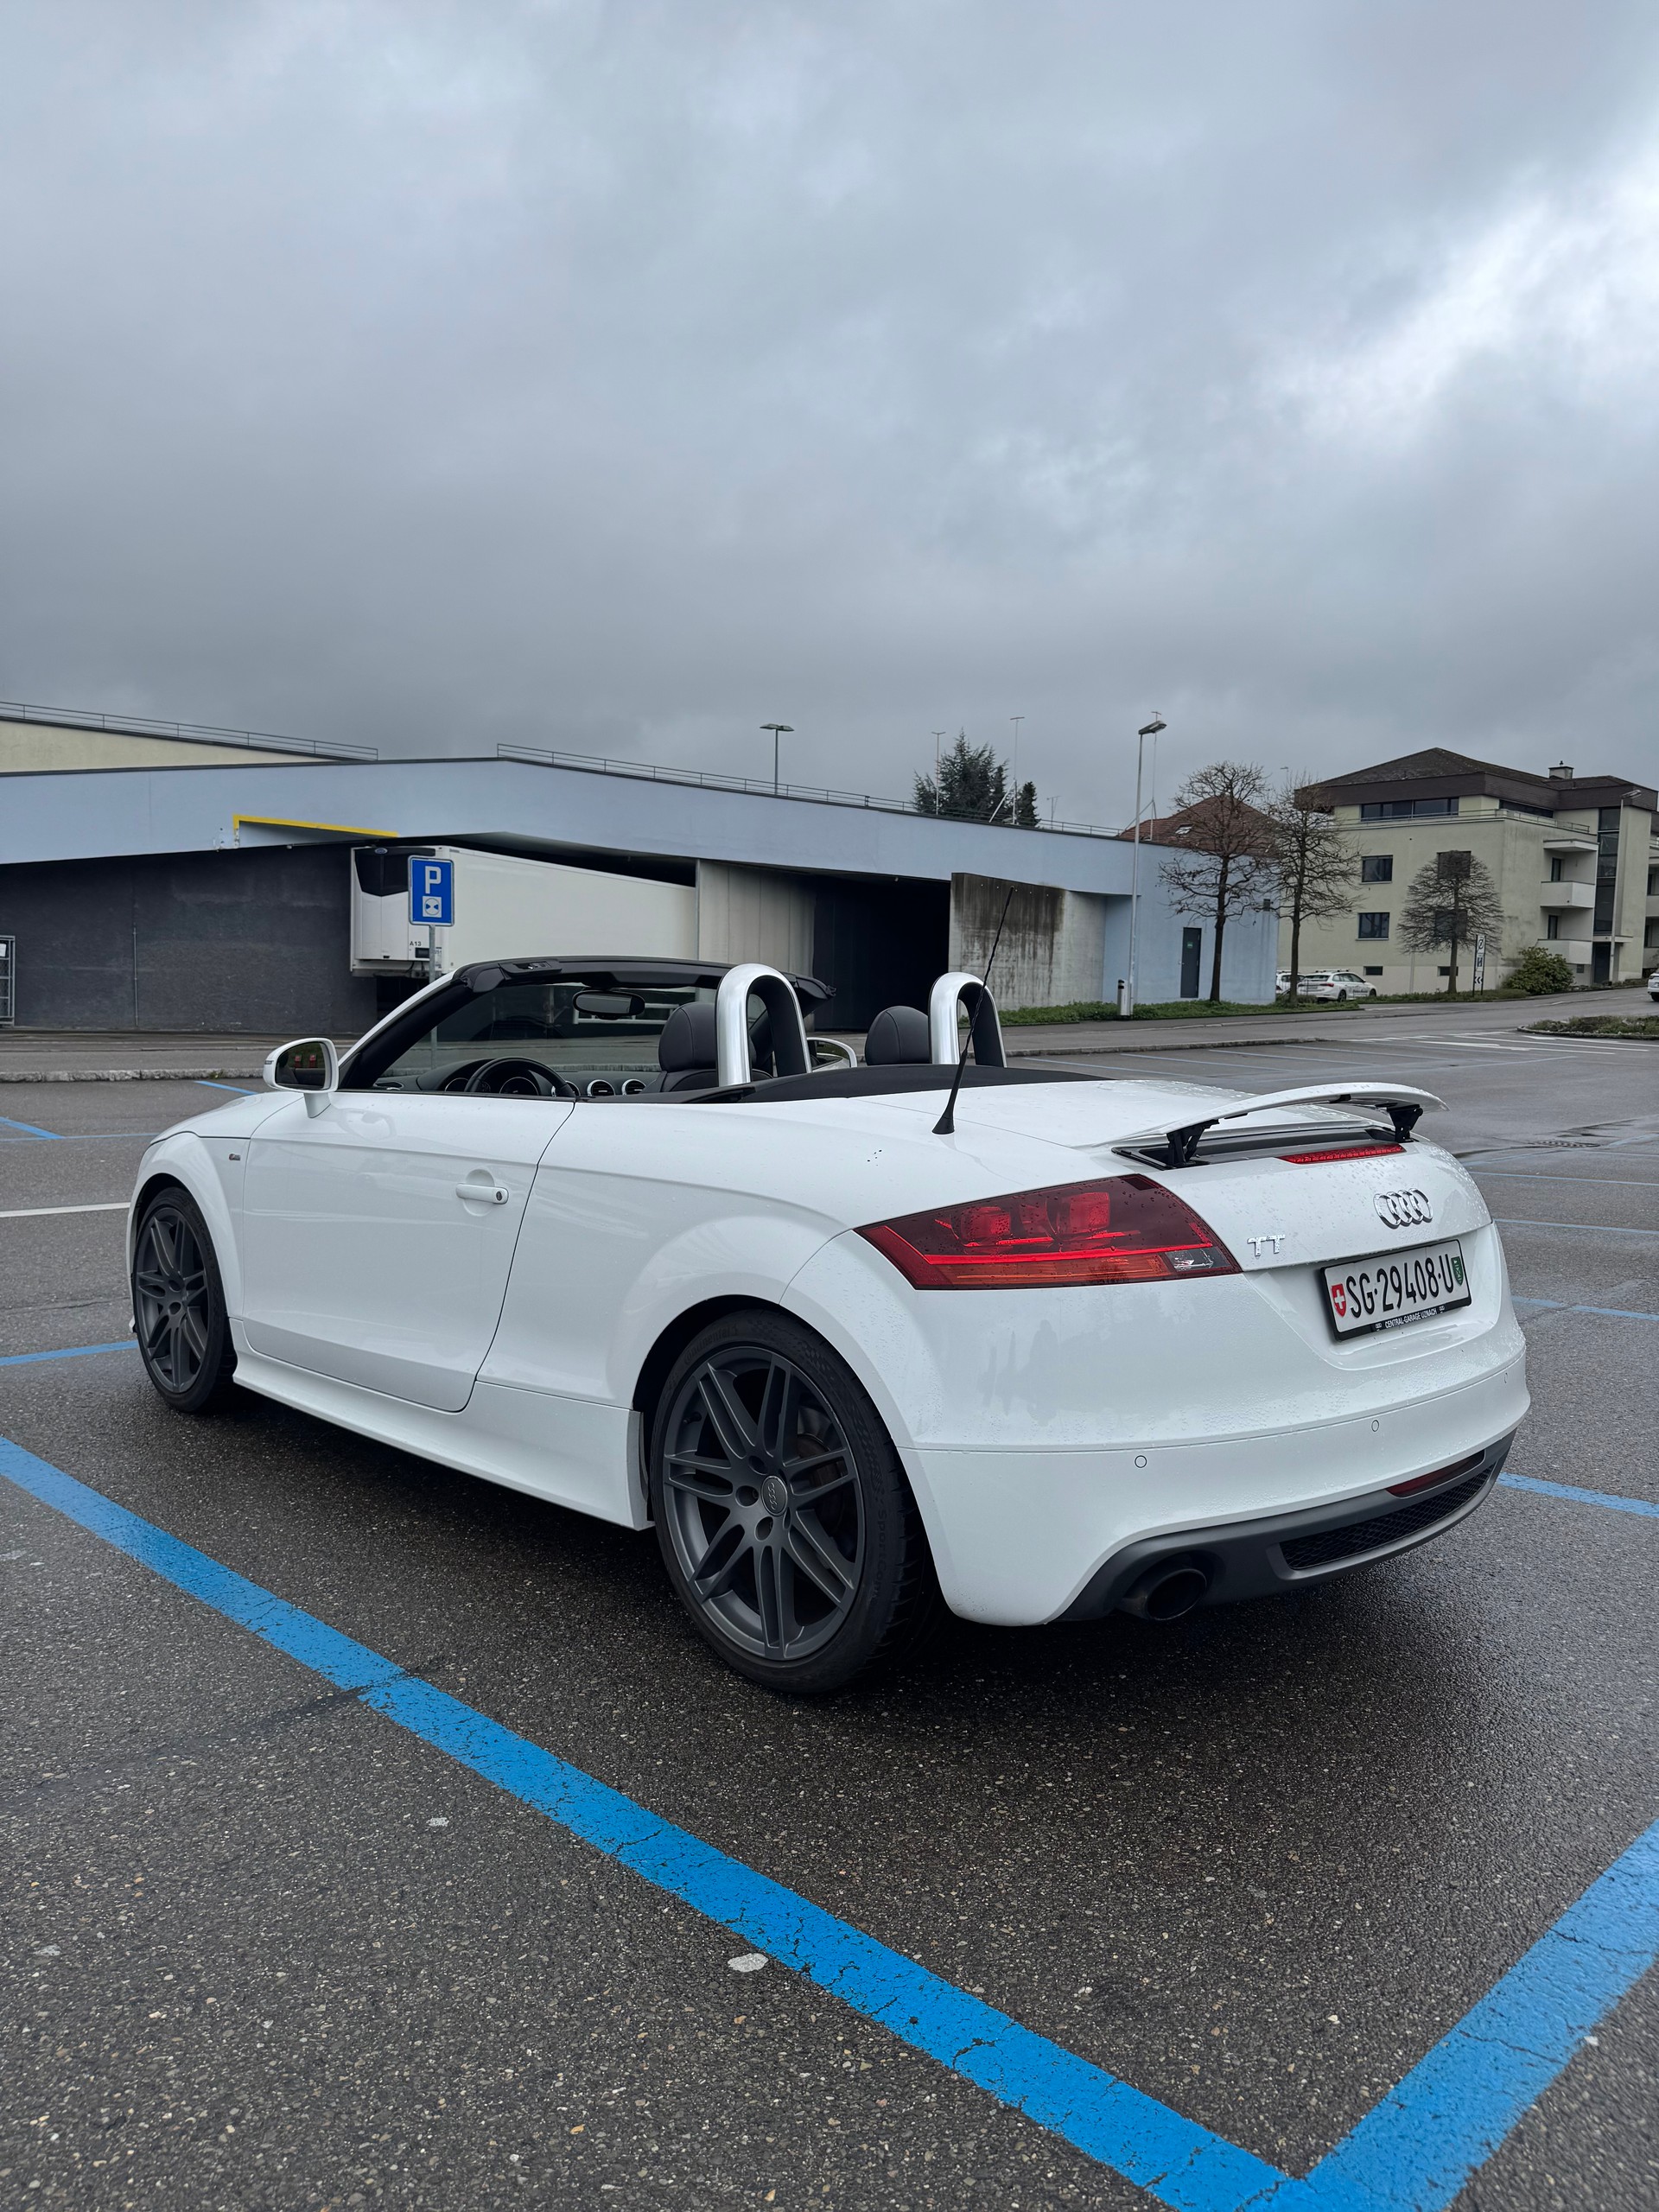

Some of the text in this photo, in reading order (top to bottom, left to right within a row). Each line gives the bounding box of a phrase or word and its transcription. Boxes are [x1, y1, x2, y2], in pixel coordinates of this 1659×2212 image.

[425, 866, 442, 893] P
[1247, 1235, 1286, 1257] TT
[1384, 1313, 1421, 1329] CENTRAL-GARAGE
